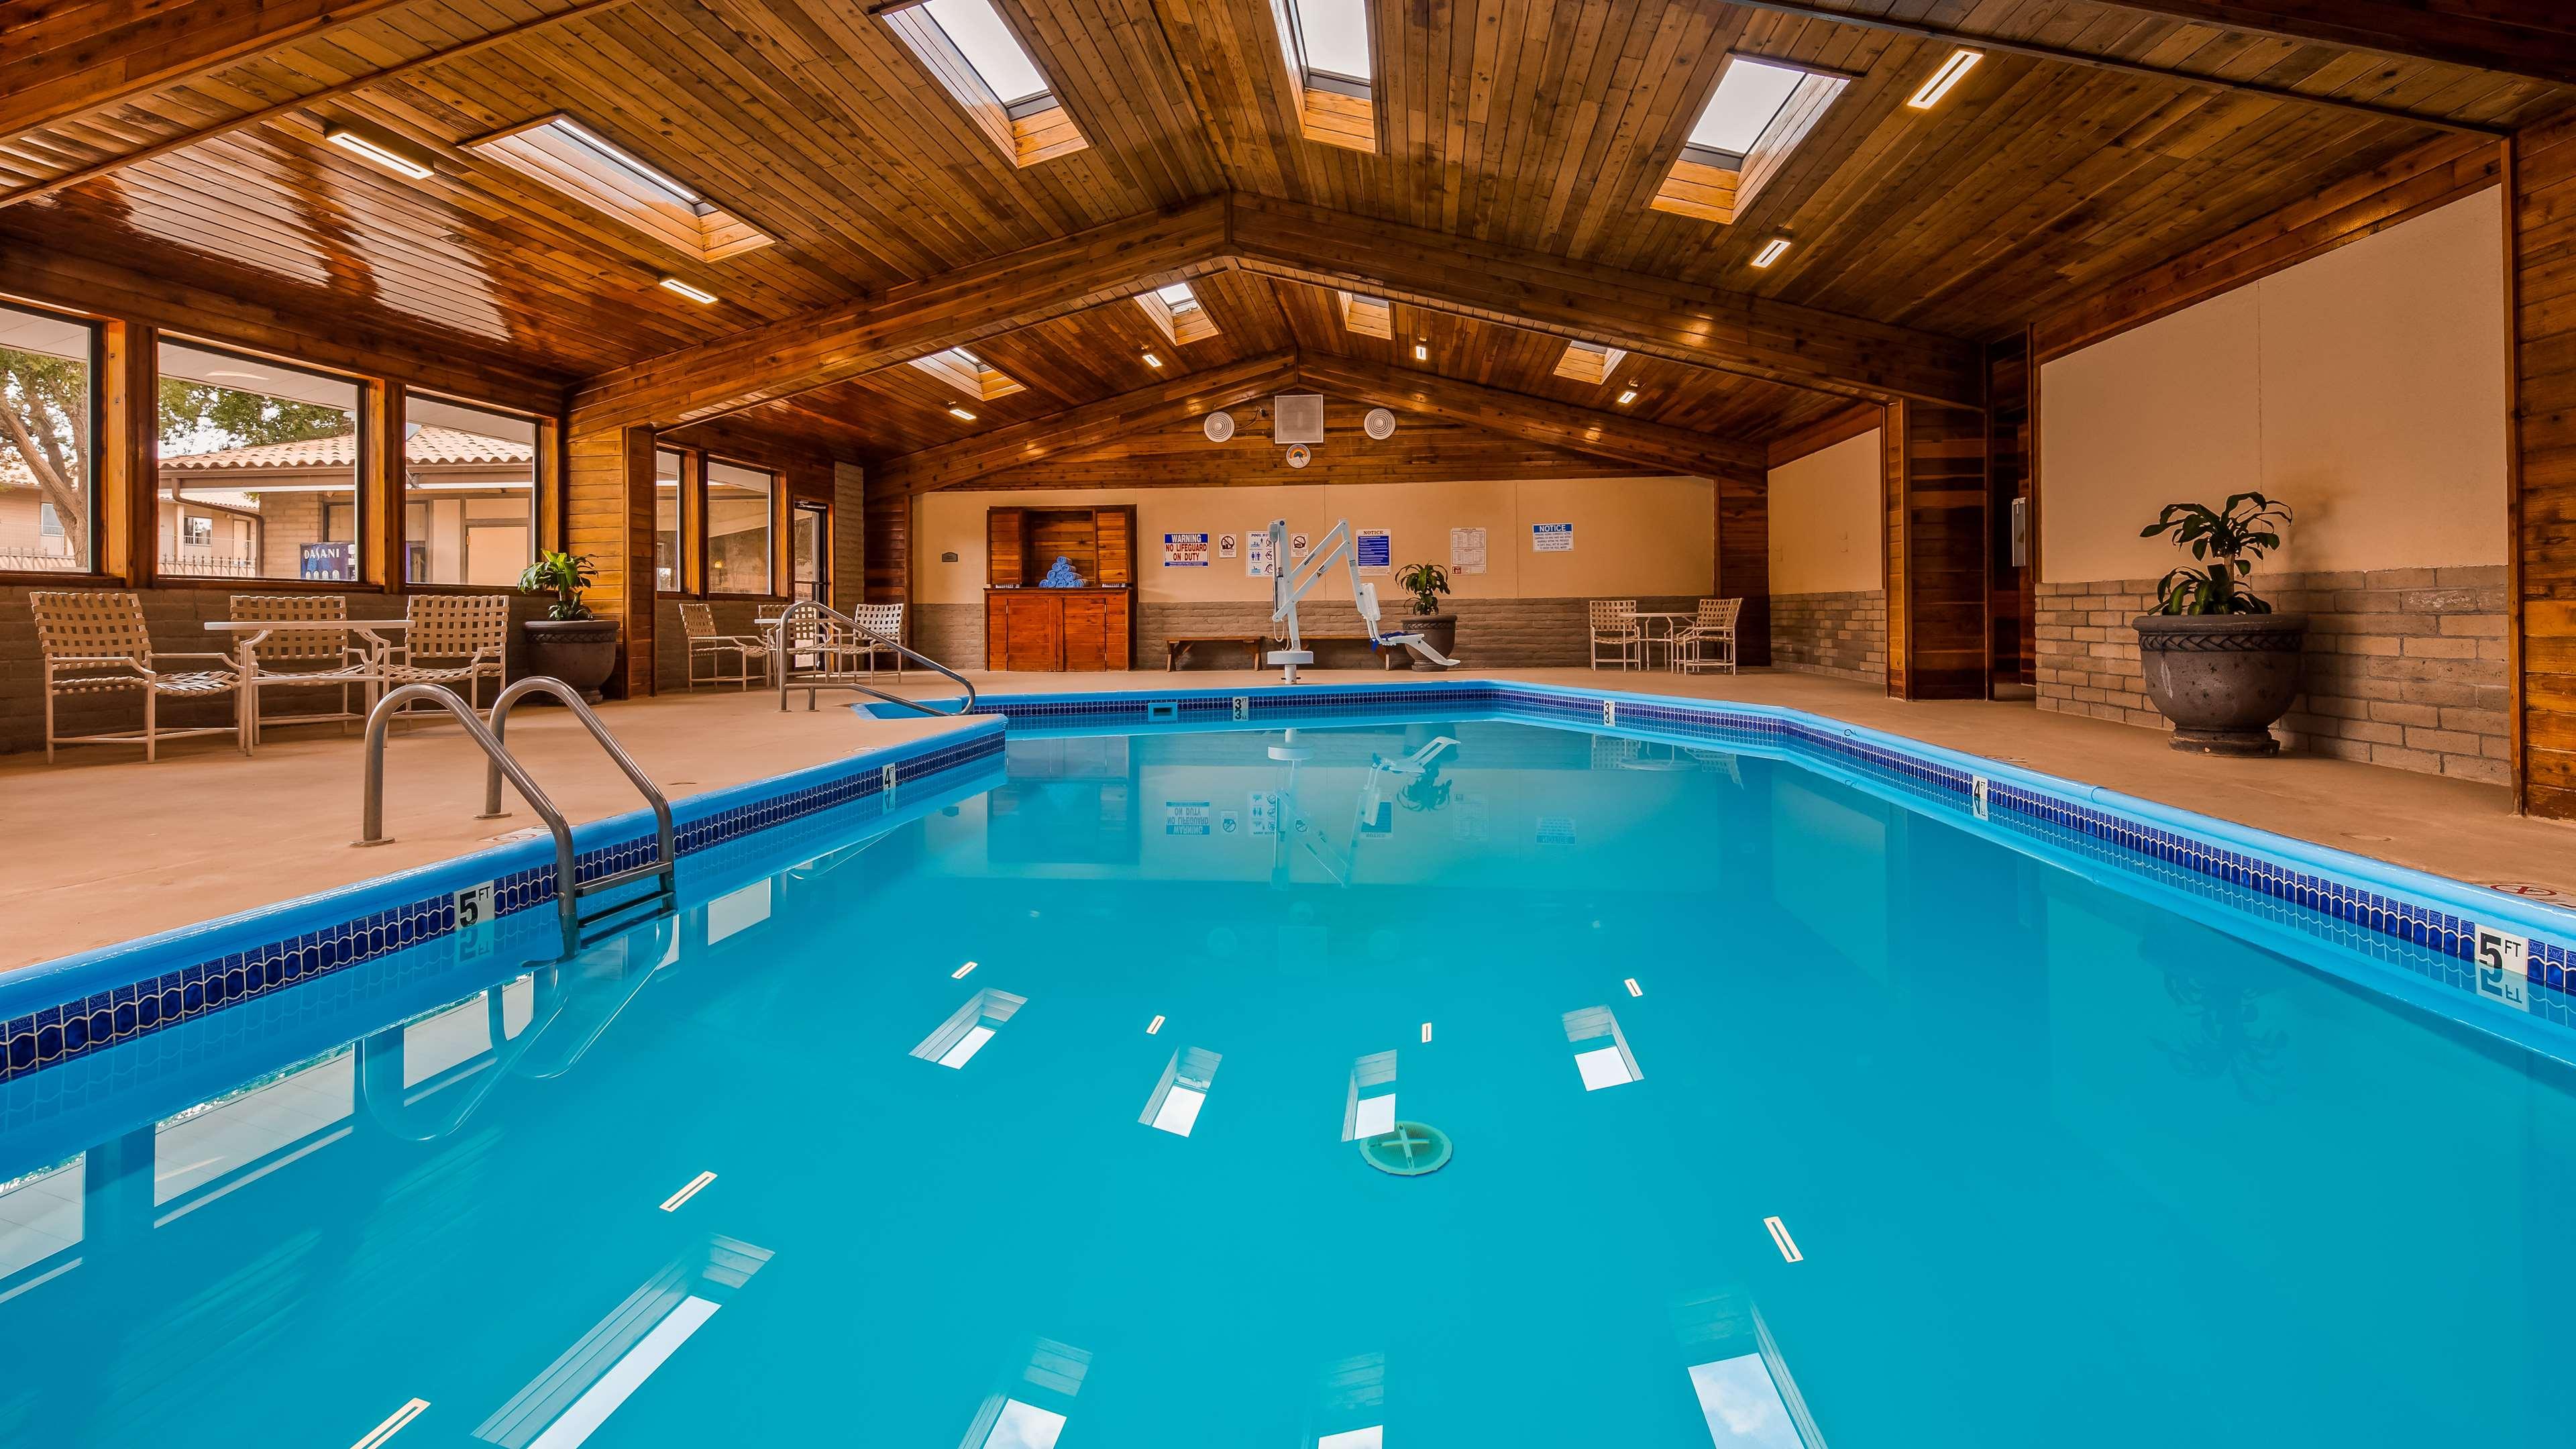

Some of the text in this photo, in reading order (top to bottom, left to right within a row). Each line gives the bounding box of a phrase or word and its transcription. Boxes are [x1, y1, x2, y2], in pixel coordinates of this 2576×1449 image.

[1171, 534, 1201, 543] WARNING
[305, 547, 339, 560] DASANI
[1165, 543, 1207, 552] NO LIFEGUARD
[1173, 553, 1199, 561] ON DUTY
[1235, 698, 1242, 710] 3
[1605, 702, 1610, 712] 3
[885, 767, 891, 788] 4
[1974, 780, 1980, 798] 4
[460, 886, 490, 927] 5 FT
[2479, 932, 2521, 969] 5 FT
